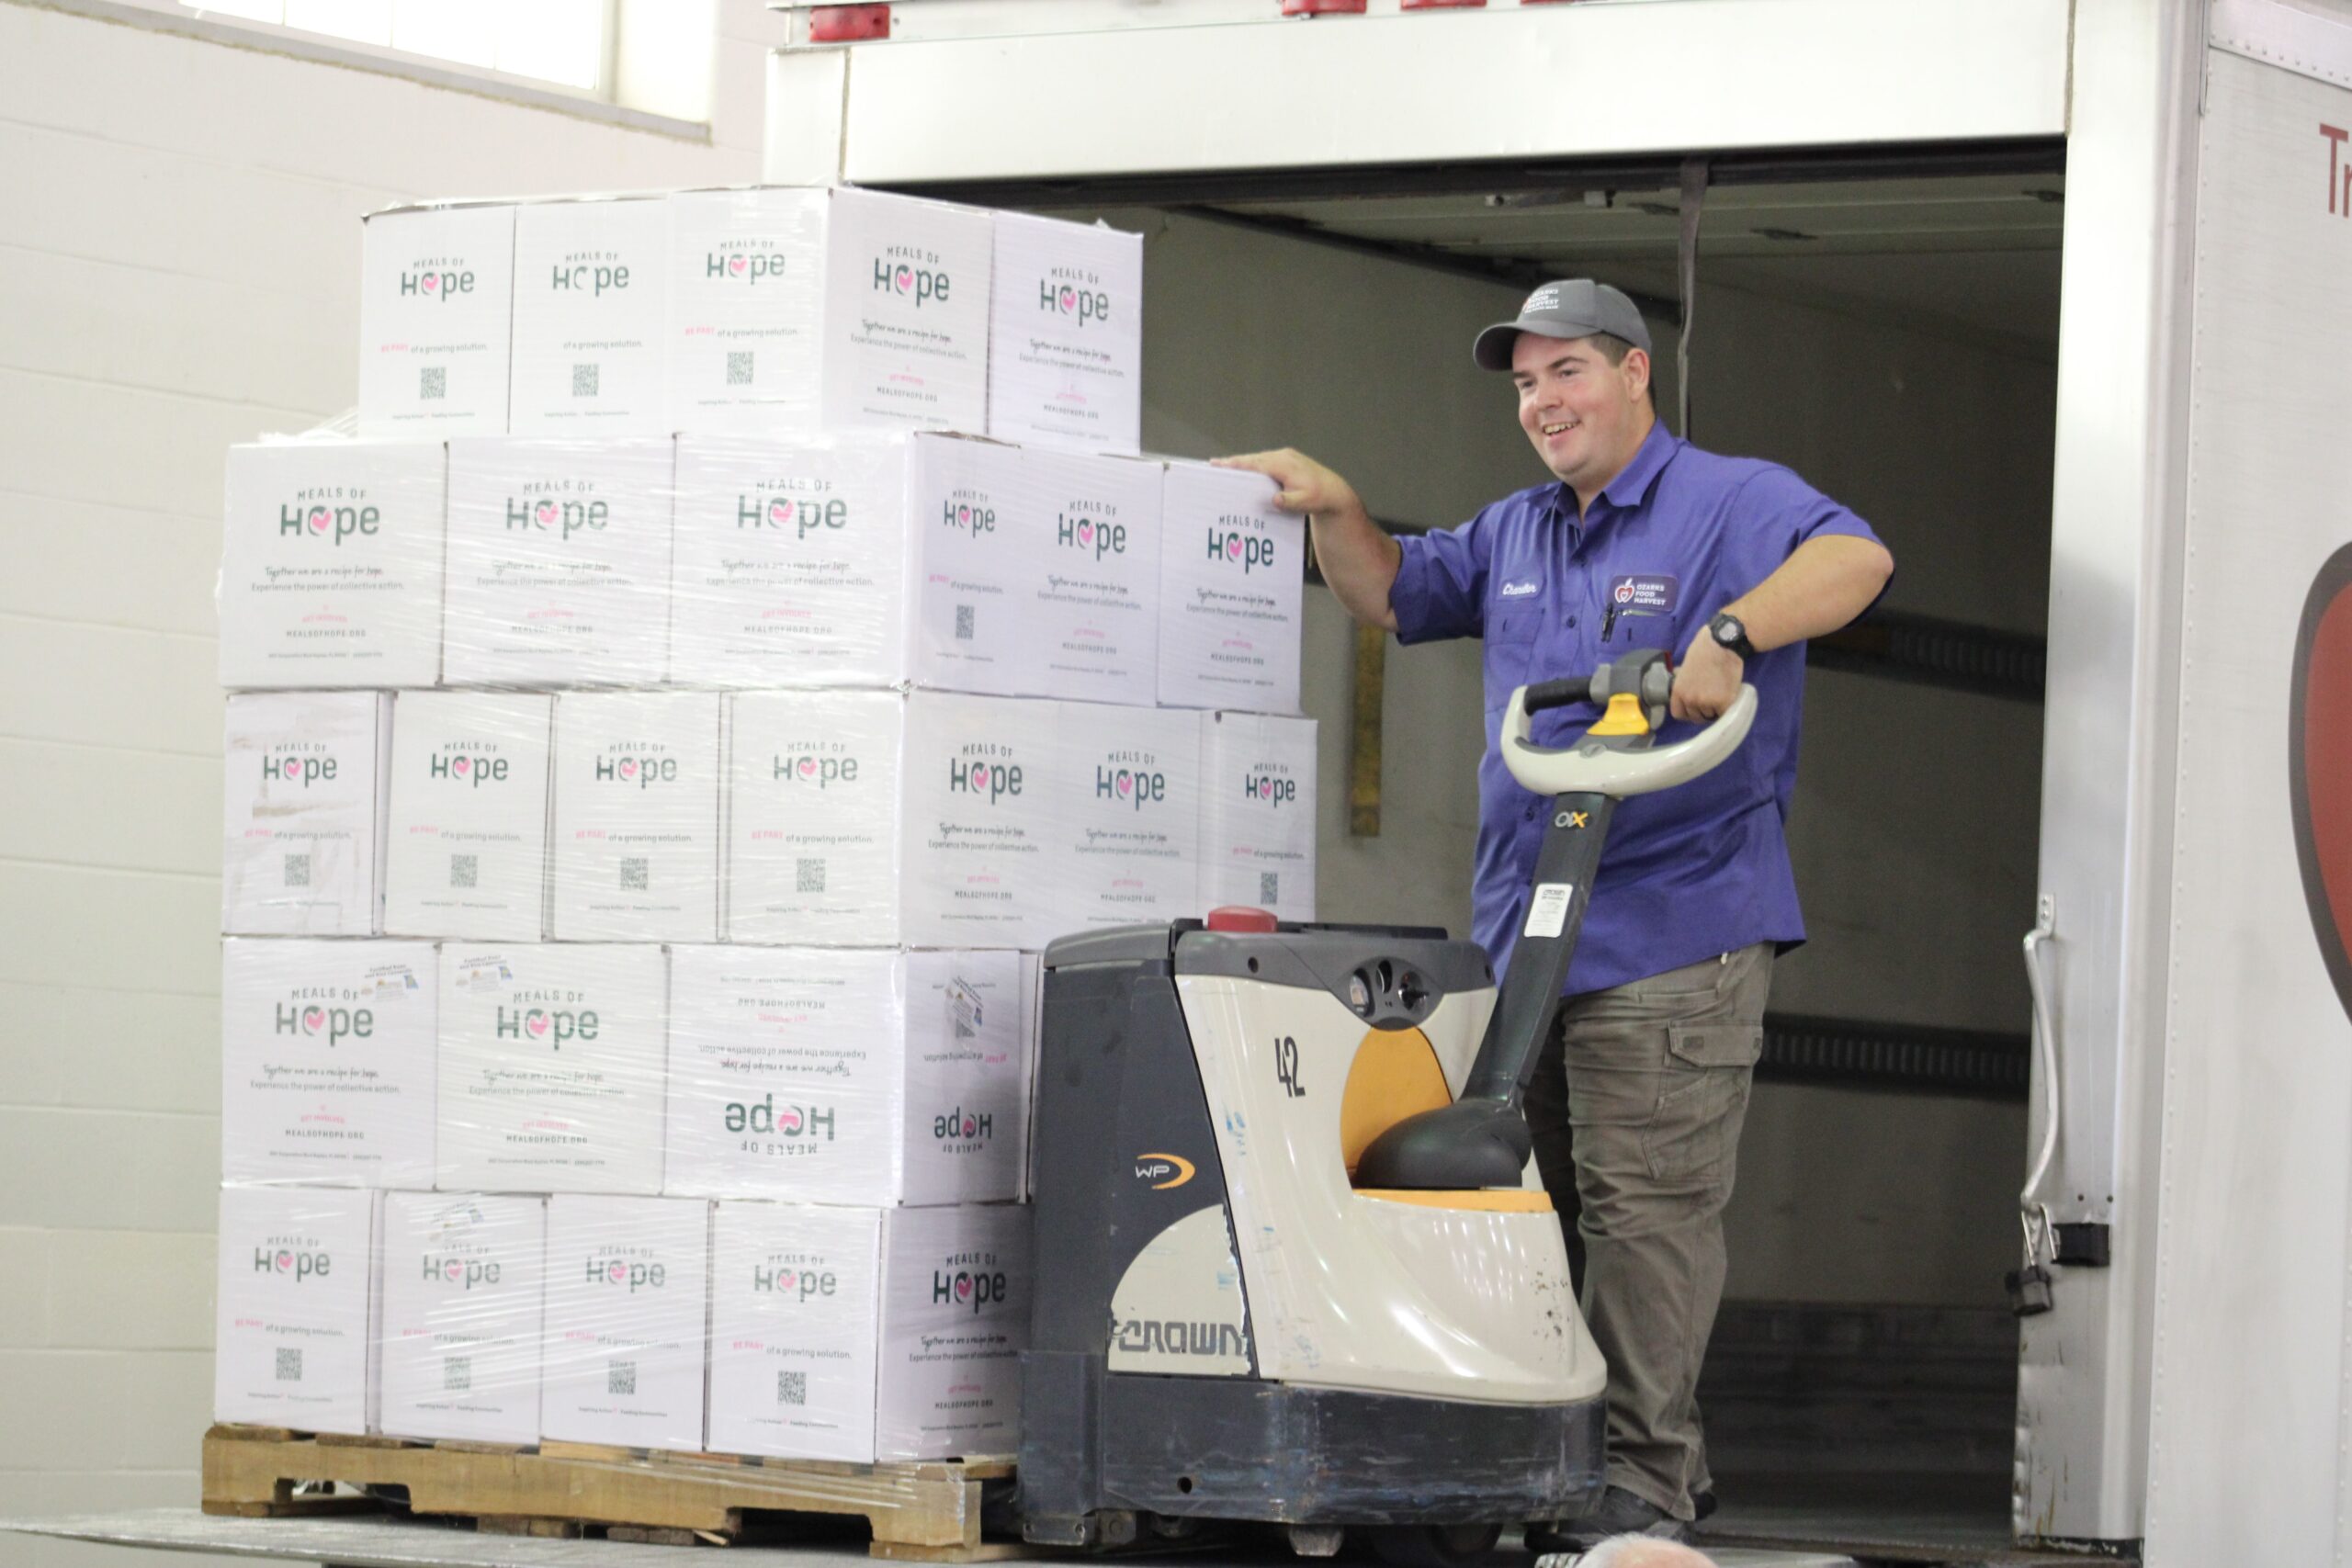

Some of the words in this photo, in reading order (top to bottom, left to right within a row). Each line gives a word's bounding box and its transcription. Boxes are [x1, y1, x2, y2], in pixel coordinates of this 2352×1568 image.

[565, 252, 602, 263] MEALS
[605, 251, 619, 261] OF
[707, 252, 786, 286] Hope
[887, 245, 922, 261] MEALS
[927, 252, 940, 265] OF
[401, 268, 476, 302] Hope
[874, 257, 950, 309] Hope
[1051, 267, 1084, 281] MEALS
[1088, 274, 1100, 286] OF
[1040, 279, 1109, 327] Hope
[297, 488, 343, 501] MEALS
[349, 488, 368, 501] OF
[524, 481, 571, 495] MEALS
[577, 482, 594, 492] OF
[756, 479, 806, 492] MEALS
[814, 480, 833, 492] OF
[280, 503, 380, 547] Hope
[506, 496, 609, 541] Hope
[737, 494, 847, 540] Hope
[944, 500, 996, 538] Hope
[1069, 500, 1102, 513] MEALS
[1104, 503, 1117, 516] OF
[1218, 514, 1250, 527] MEALS
[1254, 518, 1266, 532] OF
[1057, 513, 1126, 561] Hope
[1207, 526, 1274, 574] Hope
[1634, 598, 1666, 606] HARVEST
[276, 743, 310, 752] MEALS
[314, 743, 327, 752] OF
[444, 742, 480, 752] MEALS
[485, 743, 499, 752] OF
[609, 742, 647, 752] MEALS
[651, 743, 666, 752] OF
[786, 742, 826, 752] MEALS
[831, 743, 846, 752] OF
[962, 743, 997, 757] MEALS
[1001, 745, 1013, 757] OF
[1108, 751, 1140, 764] MEALS
[1144, 752, 1156, 765] OF
[264, 755, 337, 788] Hope
[431, 753, 509, 788] Hope
[596, 755, 677, 790] Hope
[774, 754, 858, 790] Hope
[950, 757, 1023, 806] Hope
[1097, 765, 1165, 811] Hope
[1246, 773, 1295, 808] Hope
[291, 988, 336, 1000] MEALS
[343, 989, 359, 1001] OF
[513, 990, 560, 1004] MEALS
[567, 991, 584, 1003] OF
[276, 1002, 374, 1047] Hope
[496, 1005, 599, 1051] Hope
[1275, 1036, 1306, 1098] 42
[724, 1093, 835, 1141] Hope
[933, 1106, 992, 1140] Hope
[740, 1141, 759, 1154] OF
[767, 1143, 818, 1156] MEALS
[1135, 1165, 1170, 1179] WP
[267, 1236, 302, 1247] MEALS
[307, 1238, 321, 1247] OF
[254, 1247, 331, 1282] Hope
[423, 1255, 502, 1290] Hope
[586, 1257, 666, 1293] Hope
[946, 1252, 980, 1267] MEALS
[985, 1254, 997, 1265] OF
[754, 1265, 837, 1303] Hope
[933, 1269, 1006, 1314] Hope
[1115, 1320, 1244, 1357] CROWN
